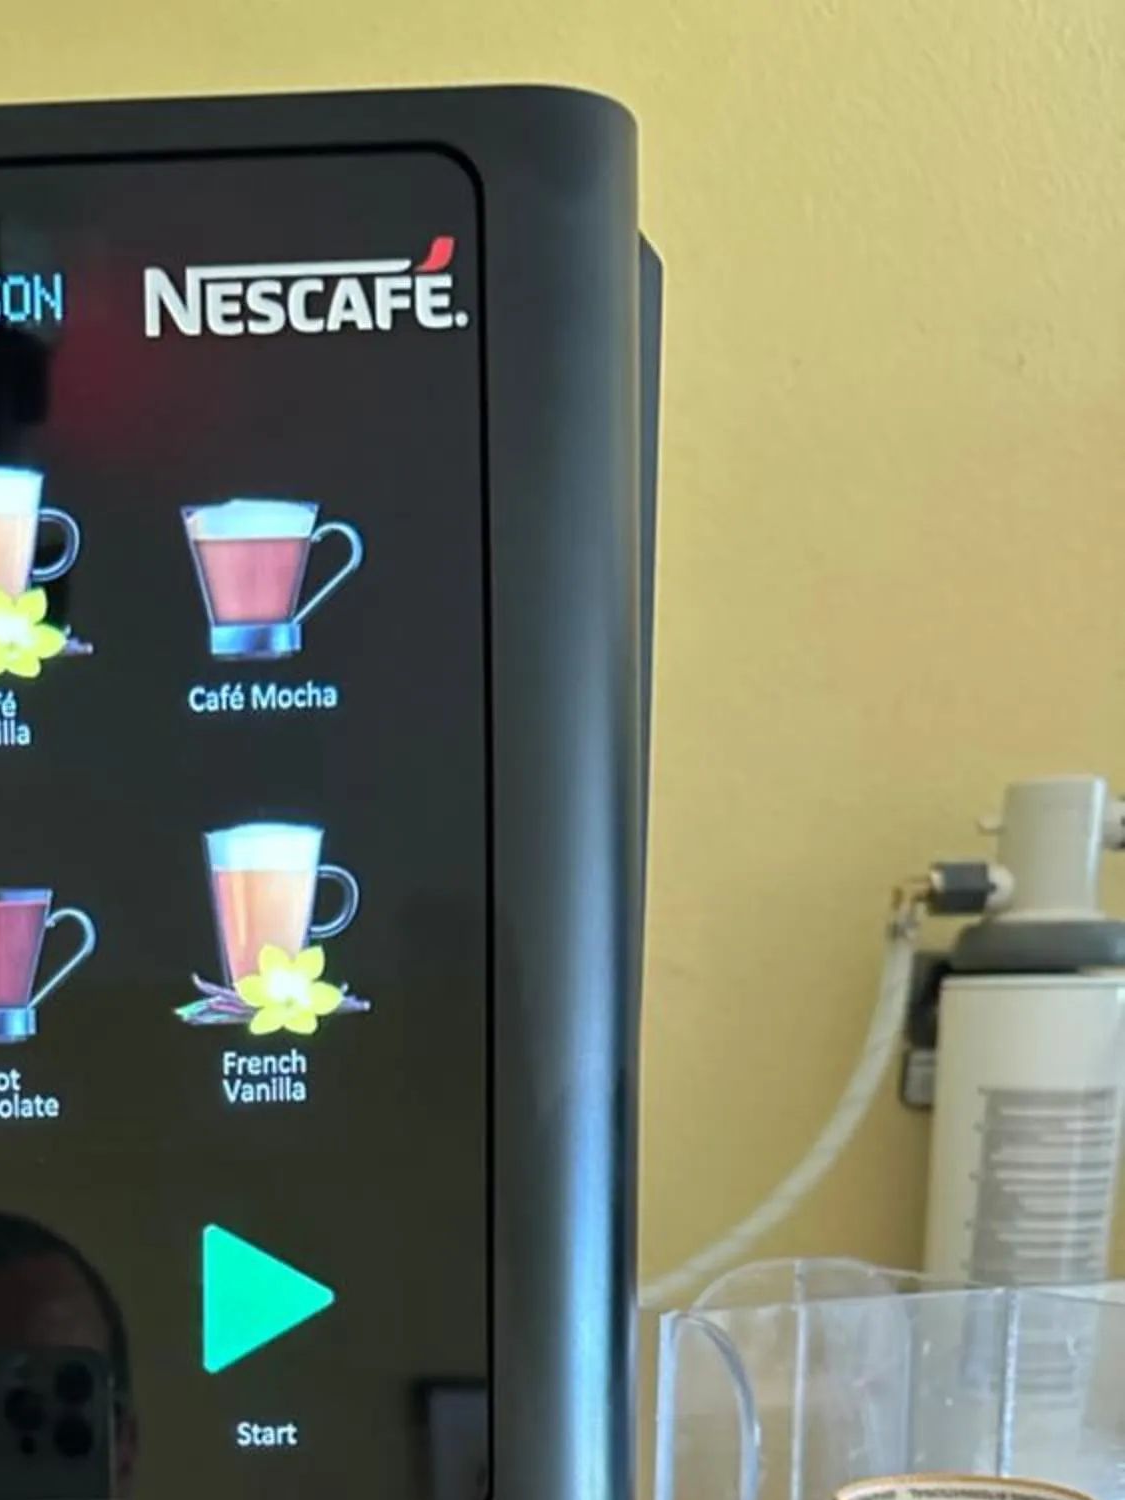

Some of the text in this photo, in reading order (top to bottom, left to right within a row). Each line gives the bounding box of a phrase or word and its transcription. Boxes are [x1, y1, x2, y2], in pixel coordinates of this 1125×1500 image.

[187, 680, 338, 712] Café Mocha
[222, 1048, 306, 1075] French
[222, 1075, 306, 1103] Vanilla
[236, 1420, 298, 1447] Start
